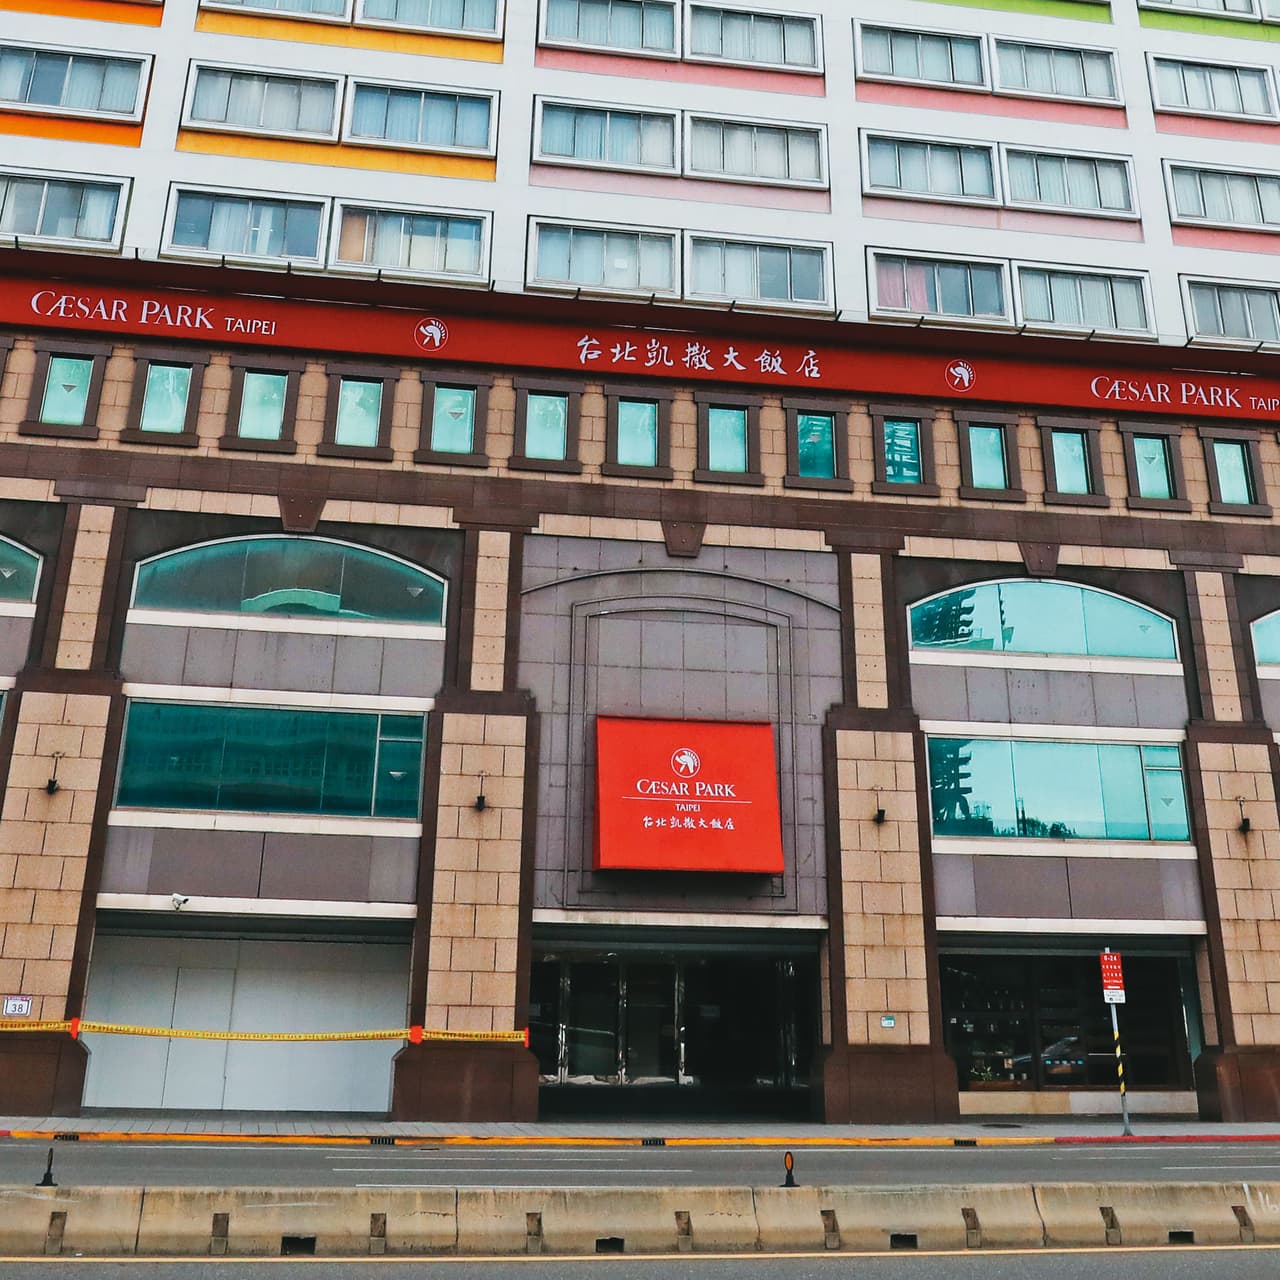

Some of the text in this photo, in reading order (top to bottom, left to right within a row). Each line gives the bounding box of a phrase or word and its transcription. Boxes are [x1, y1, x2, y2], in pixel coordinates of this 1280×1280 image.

[138, 300, 214, 329] PARK
[224, 317, 276, 336] TAIPEI
[576, 333, 821, 378] 台北凱撒大飯店
[1180, 382, 1242, 408] PARK
[695, 781, 737, 798] PARK
[674, 803, 701, 812] TAIPEI
[642, 815, 735, 831] 台北凱撒大飯店
[11, 1003, 24, 1013] 38
